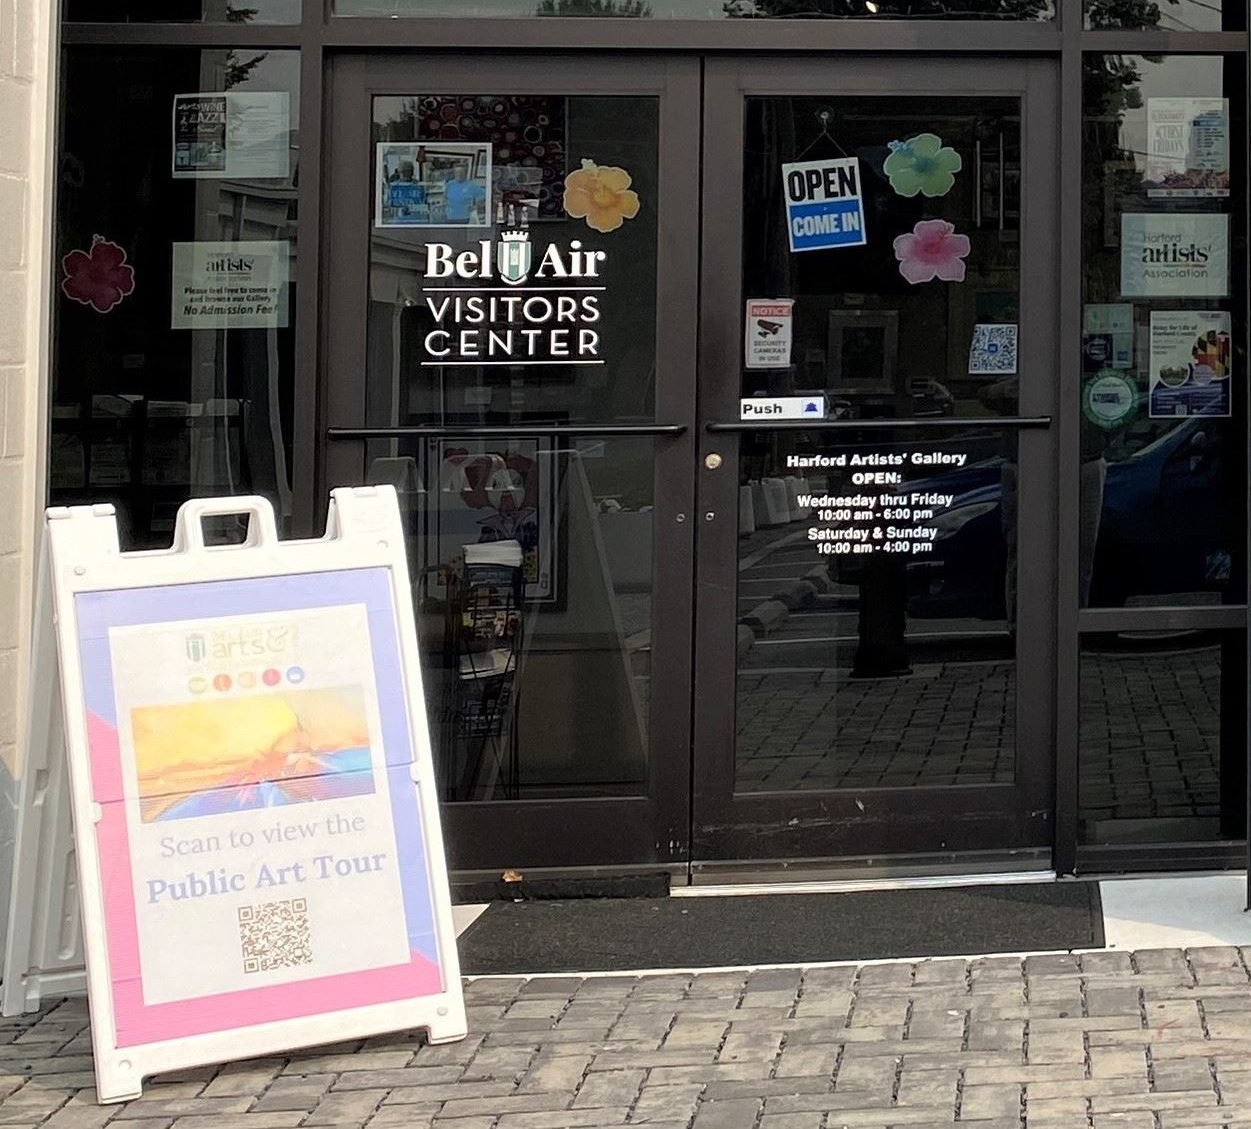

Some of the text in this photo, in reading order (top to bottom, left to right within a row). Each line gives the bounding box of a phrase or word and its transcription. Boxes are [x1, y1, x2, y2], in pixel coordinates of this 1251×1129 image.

[788, 166, 857, 202] OPEN
[793, 211, 859, 237] COME IN
[424, 240, 606, 278] Bel Air
[184, 305, 197, 315] No
[200, 304, 253, 315] Admission
[426, 296, 600, 322] VISITORS
[752, 307, 790, 316] NOTICE
[424, 329, 599, 356] CENTER
[743, 404, 782, 414] Push
[787, 452, 967, 468] Harford Artists' Gallery
[852, 472, 902, 485] OPEN:
[797, 493, 954, 509] Wednesday thru Friday
[817, 509, 851, 520] 10:00
[854, 511, 873, 520] am
[883, 508, 911, 519] 6:00
[913, 510, 933, 521] pm
[807, 526, 937, 541] Saturday & Sunday
[817, 542, 850, 553] 10:00
[853, 544, 872, 553] am
[883, 541, 910, 552] 4:00
[912, 542, 932, 554] pm
[160, 813, 365, 858] Scan to view the
[147, 853, 386, 904] Public Art Tour
